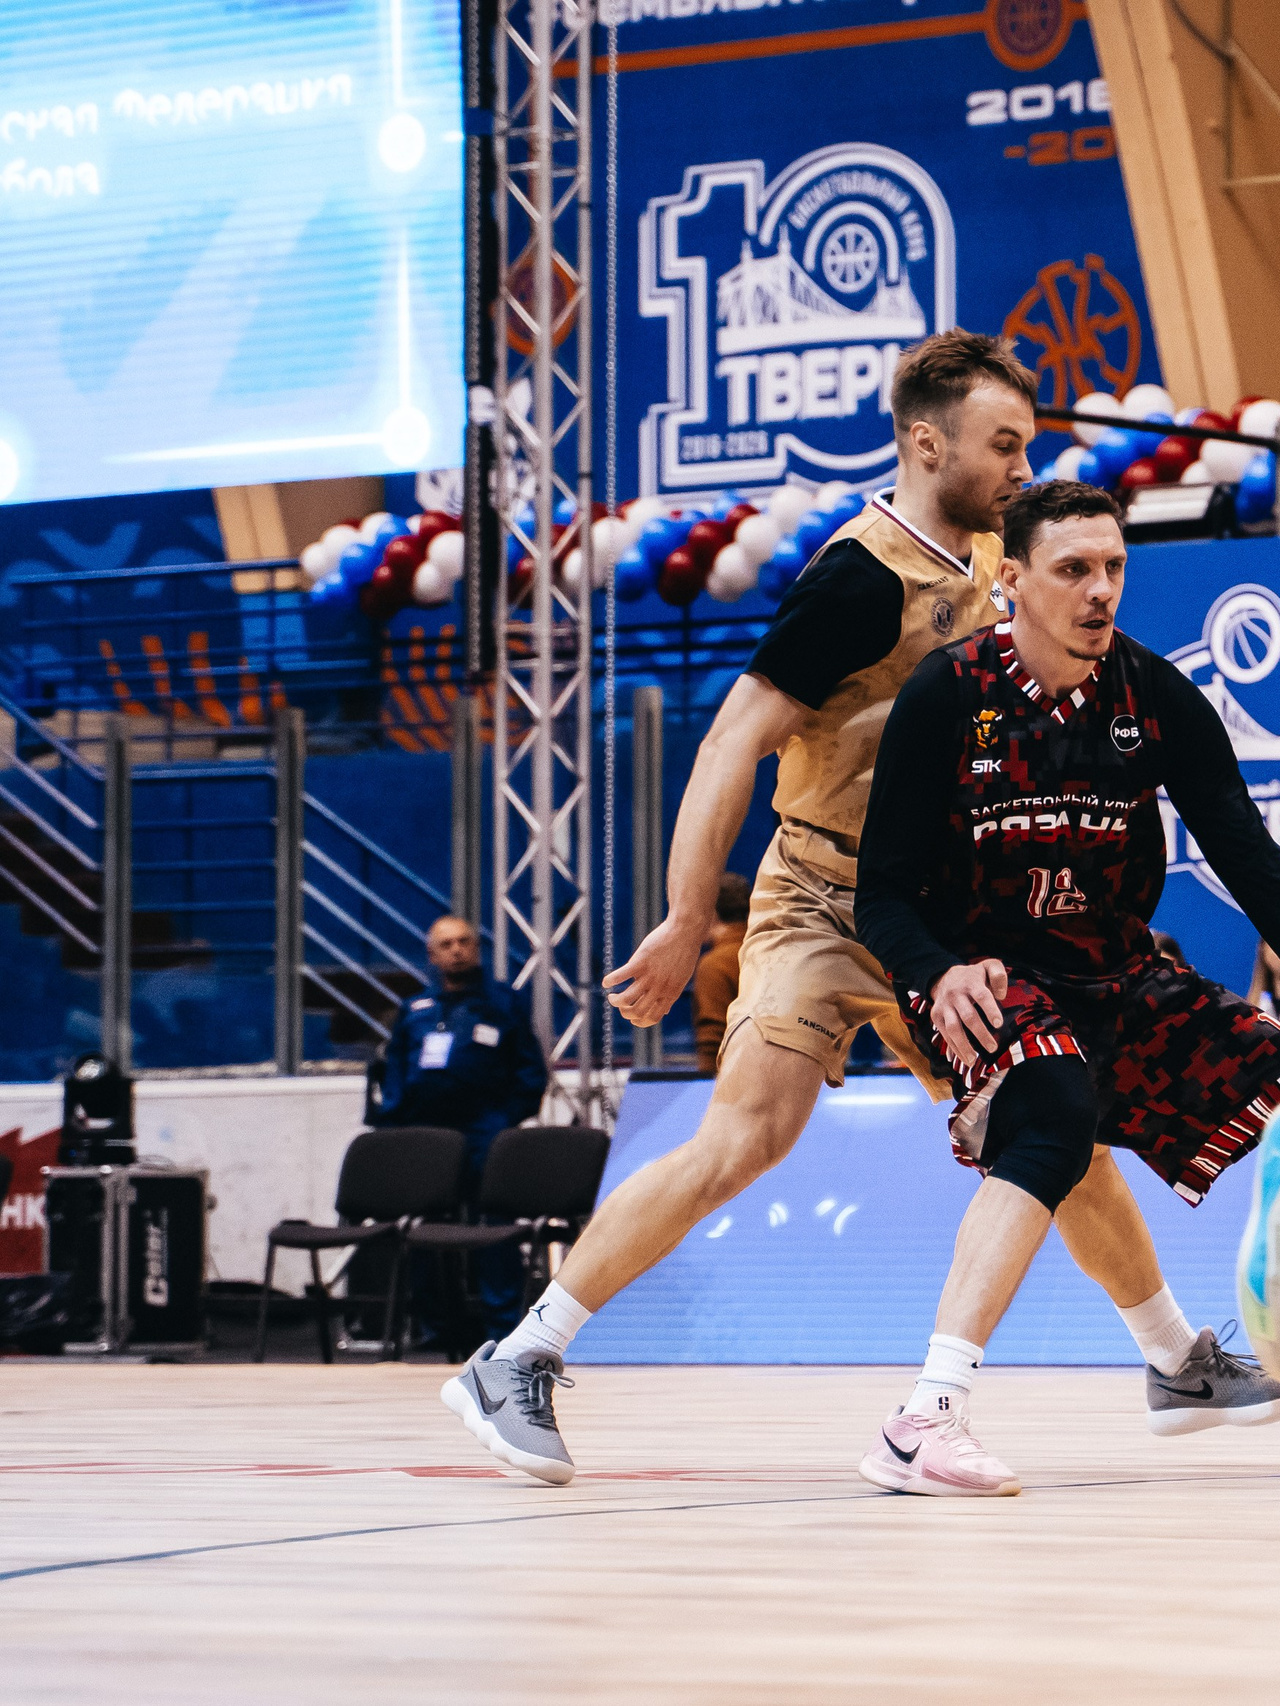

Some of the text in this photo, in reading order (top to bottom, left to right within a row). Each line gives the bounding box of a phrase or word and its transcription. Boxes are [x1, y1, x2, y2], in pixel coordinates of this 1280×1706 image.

[1114, 726, 1139, 738] РФБ
[971, 759, 1002, 773] STK
[1027, 867, 1088, 918] 12
